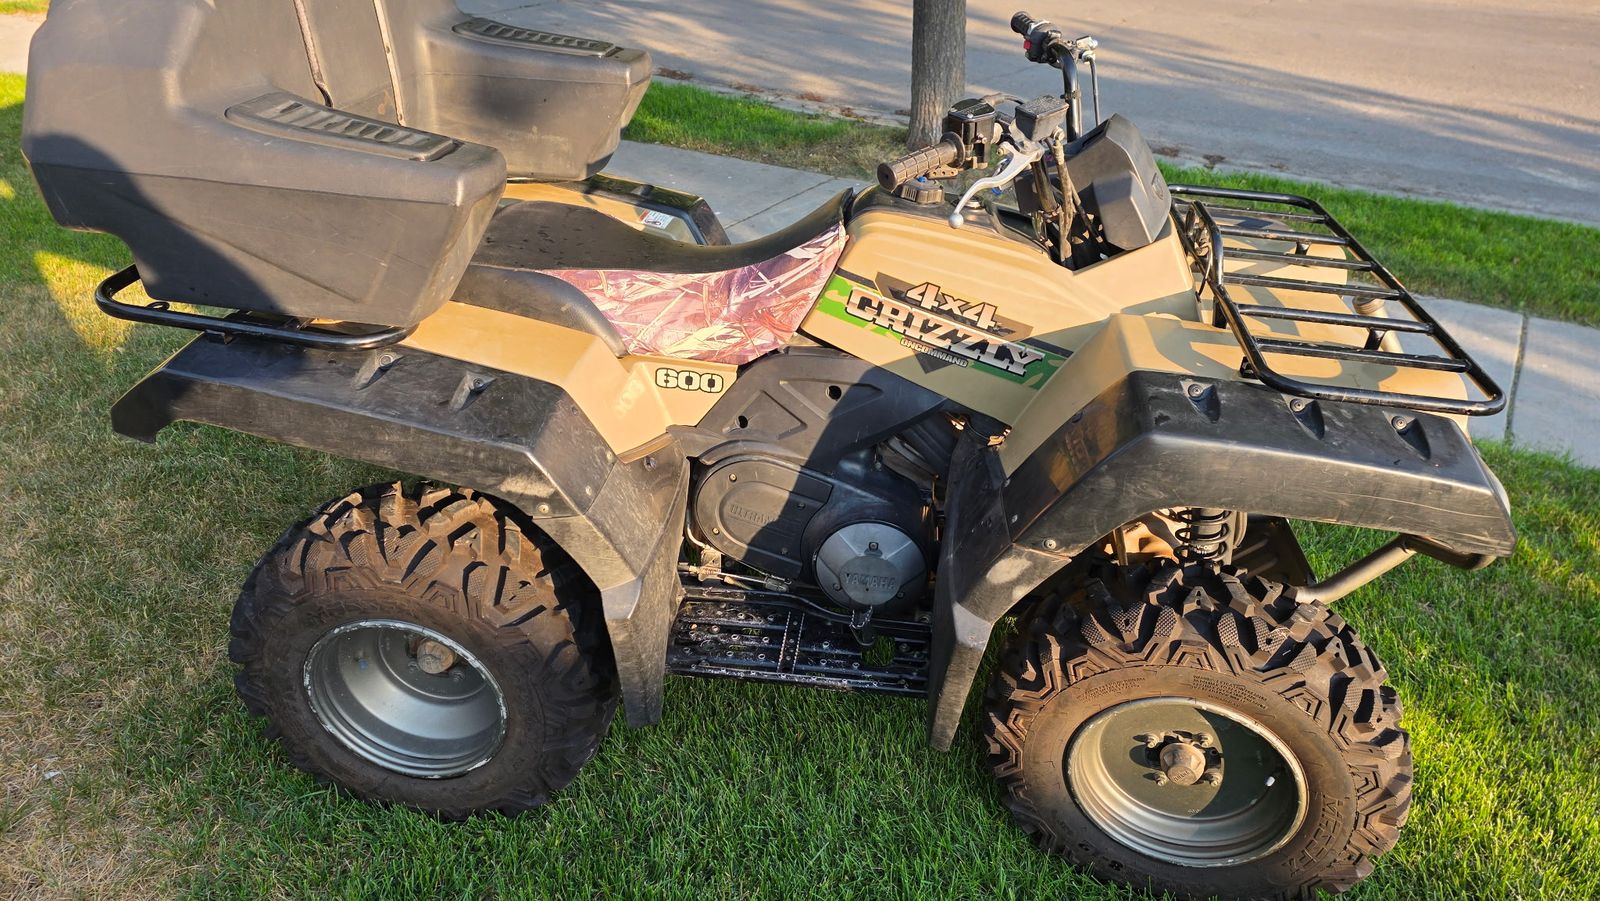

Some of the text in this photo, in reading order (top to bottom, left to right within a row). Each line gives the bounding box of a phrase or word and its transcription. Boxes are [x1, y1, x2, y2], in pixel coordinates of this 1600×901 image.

[905, 282, 998, 329] 4x4
[845, 286, 1046, 377] GRIZZLY
[655, 368, 723, 393] 600
[844, 572, 897, 591] YAMAHA
